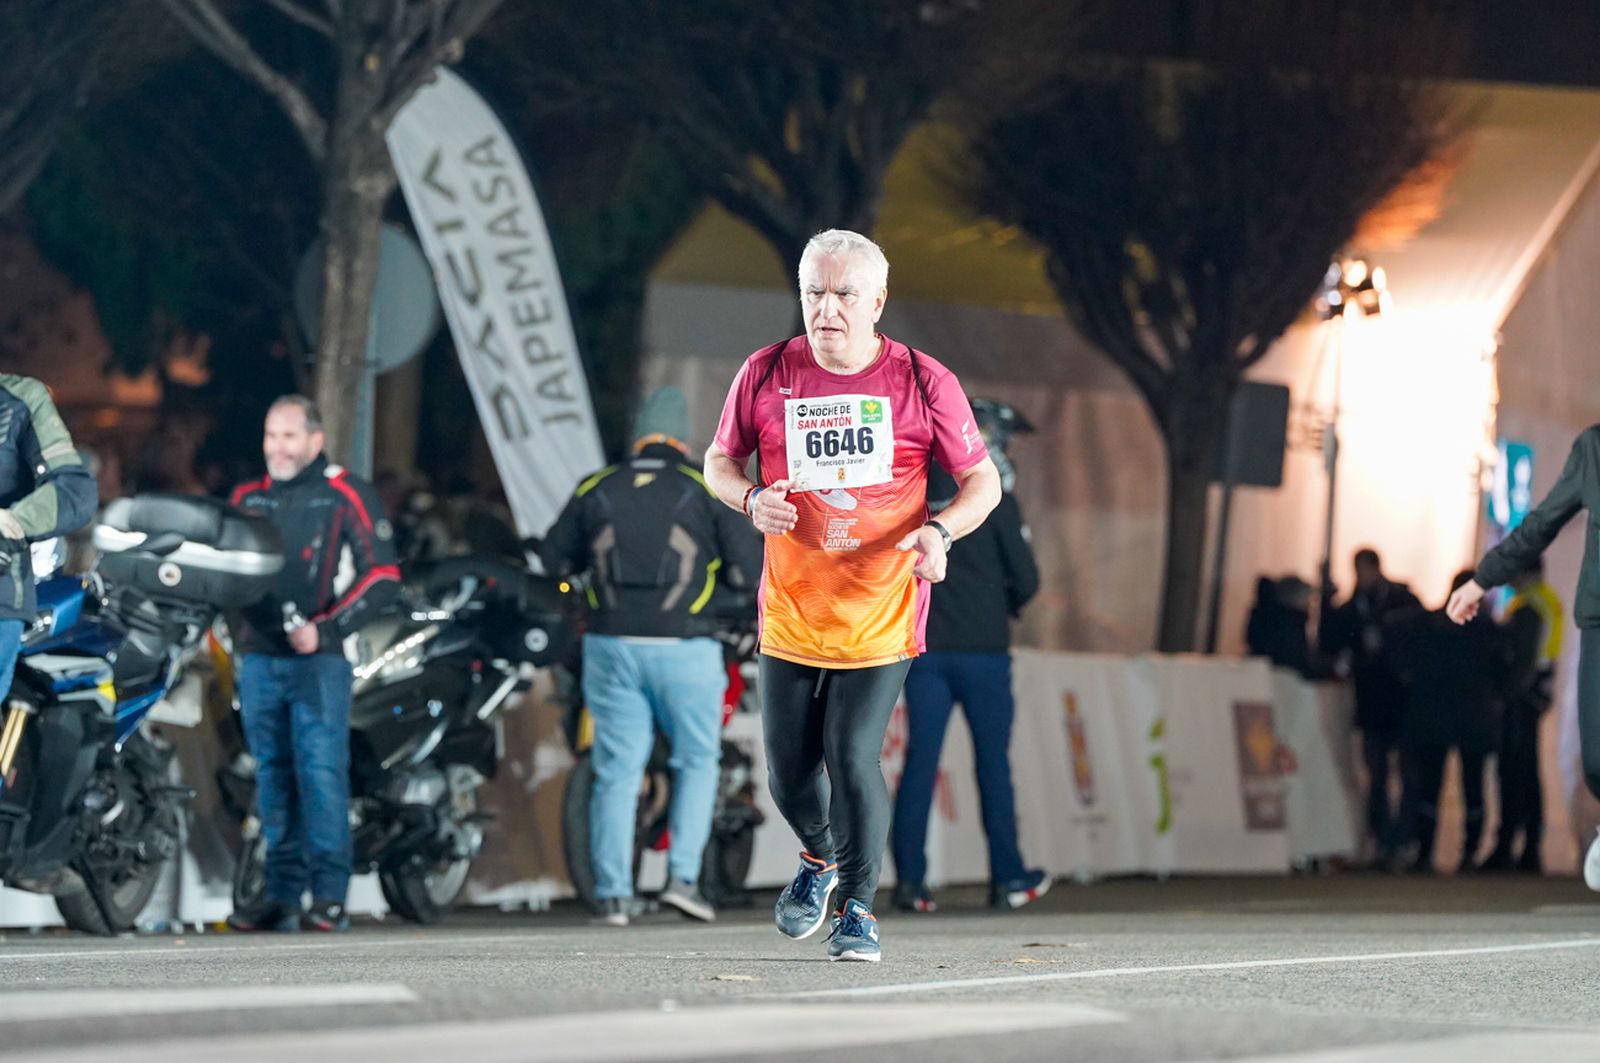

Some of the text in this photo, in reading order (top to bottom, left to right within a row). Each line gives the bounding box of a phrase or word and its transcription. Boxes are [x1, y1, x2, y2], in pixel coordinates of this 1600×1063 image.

[464, 134, 585, 426] JAPEMASA
[809, 407, 838, 417] NOCHE
[840, 405, 851, 414] DE
[797, 418, 817, 430] SAN
[819, 414, 852, 428] ANTÓN
[805, 426, 874, 459] 6646
[816, 457, 865, 467] Francisco Javier
[827, 529, 849, 538] SAN
[826, 536, 862, 547] ANTÓN
